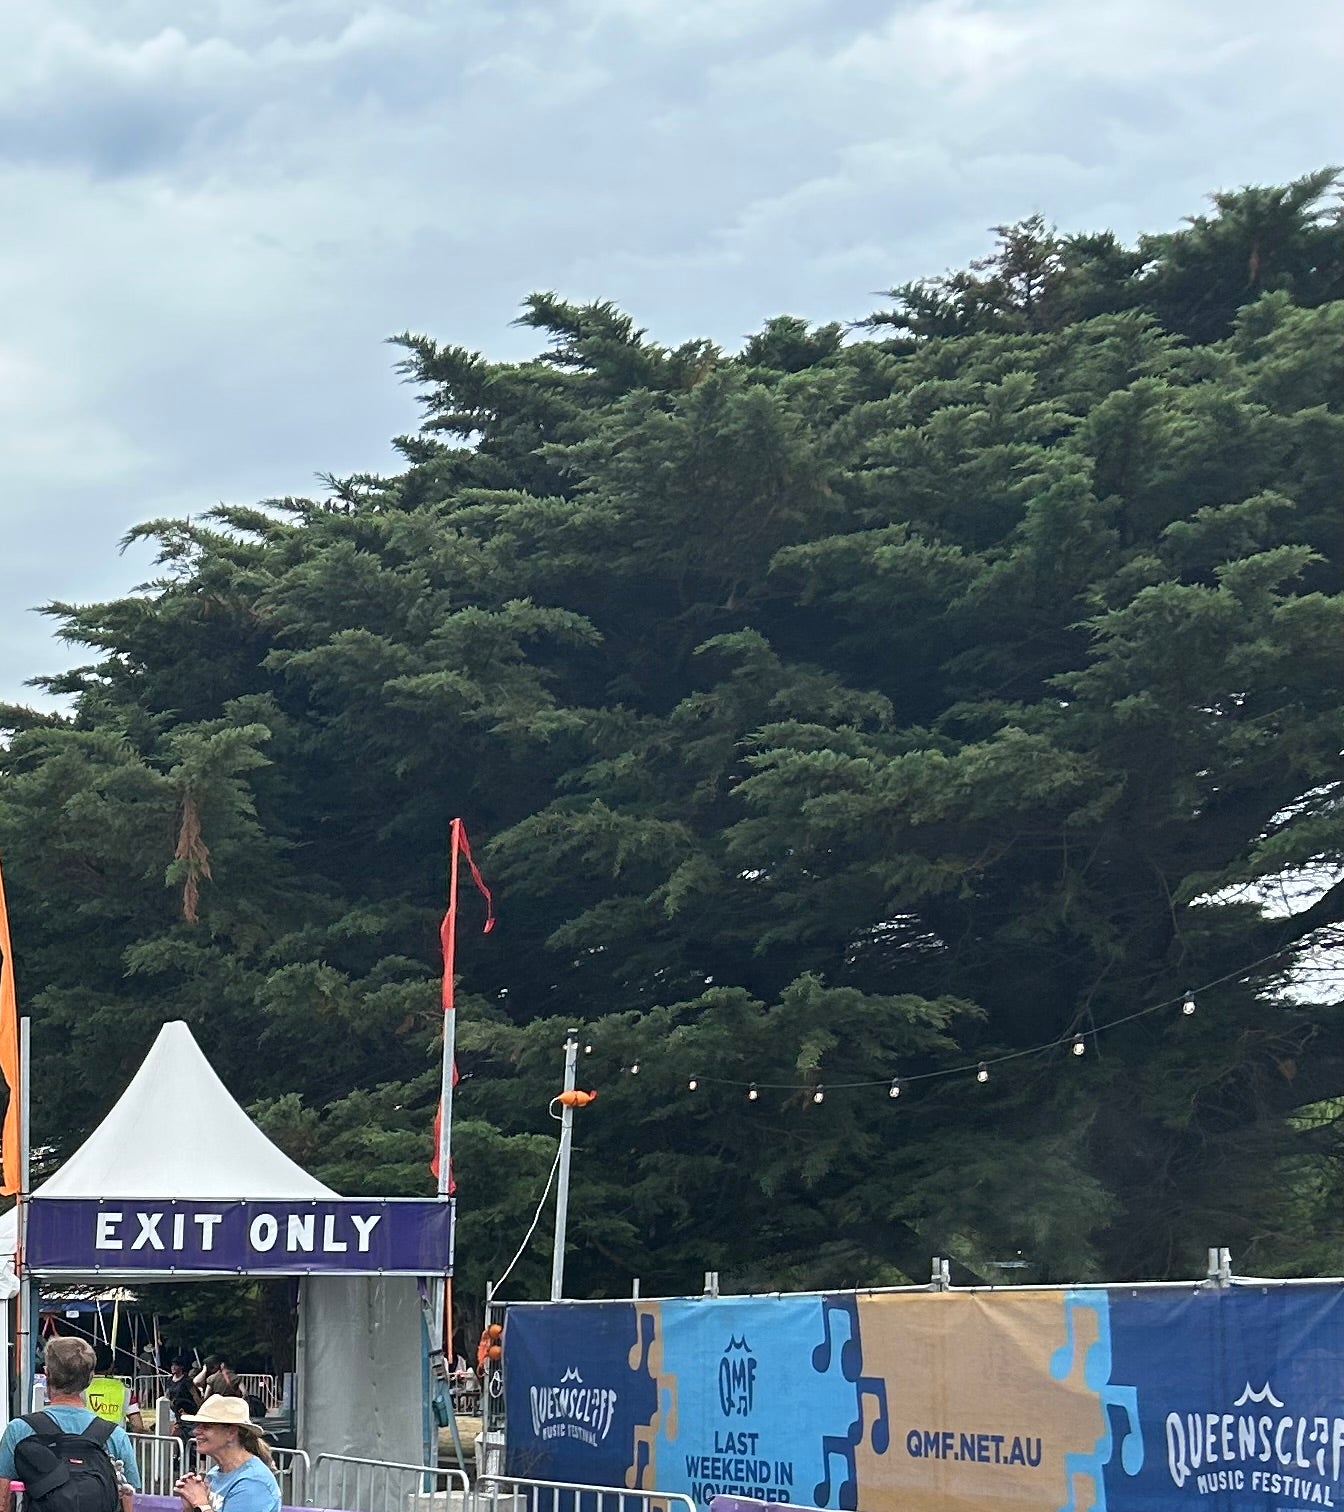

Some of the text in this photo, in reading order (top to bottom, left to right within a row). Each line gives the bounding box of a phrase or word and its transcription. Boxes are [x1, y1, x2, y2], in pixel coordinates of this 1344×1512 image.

[95, 1213, 382, 1253] EXIT ONLY
[718, 1356, 758, 1417] QMF
[542, 1423, 599, 1448] MUSIC FESTIVAL
[714, 1431, 759, 1456] LAST
[906, 1429, 1043, 1468] QMF.NET.AU
[1165, 1411, 1344, 1488] QUEENSCLIF
[686, 1455, 794, 1486] WEEKEND IN
[1197, 1469, 1335, 1508] MUSIC FESTIVAL
